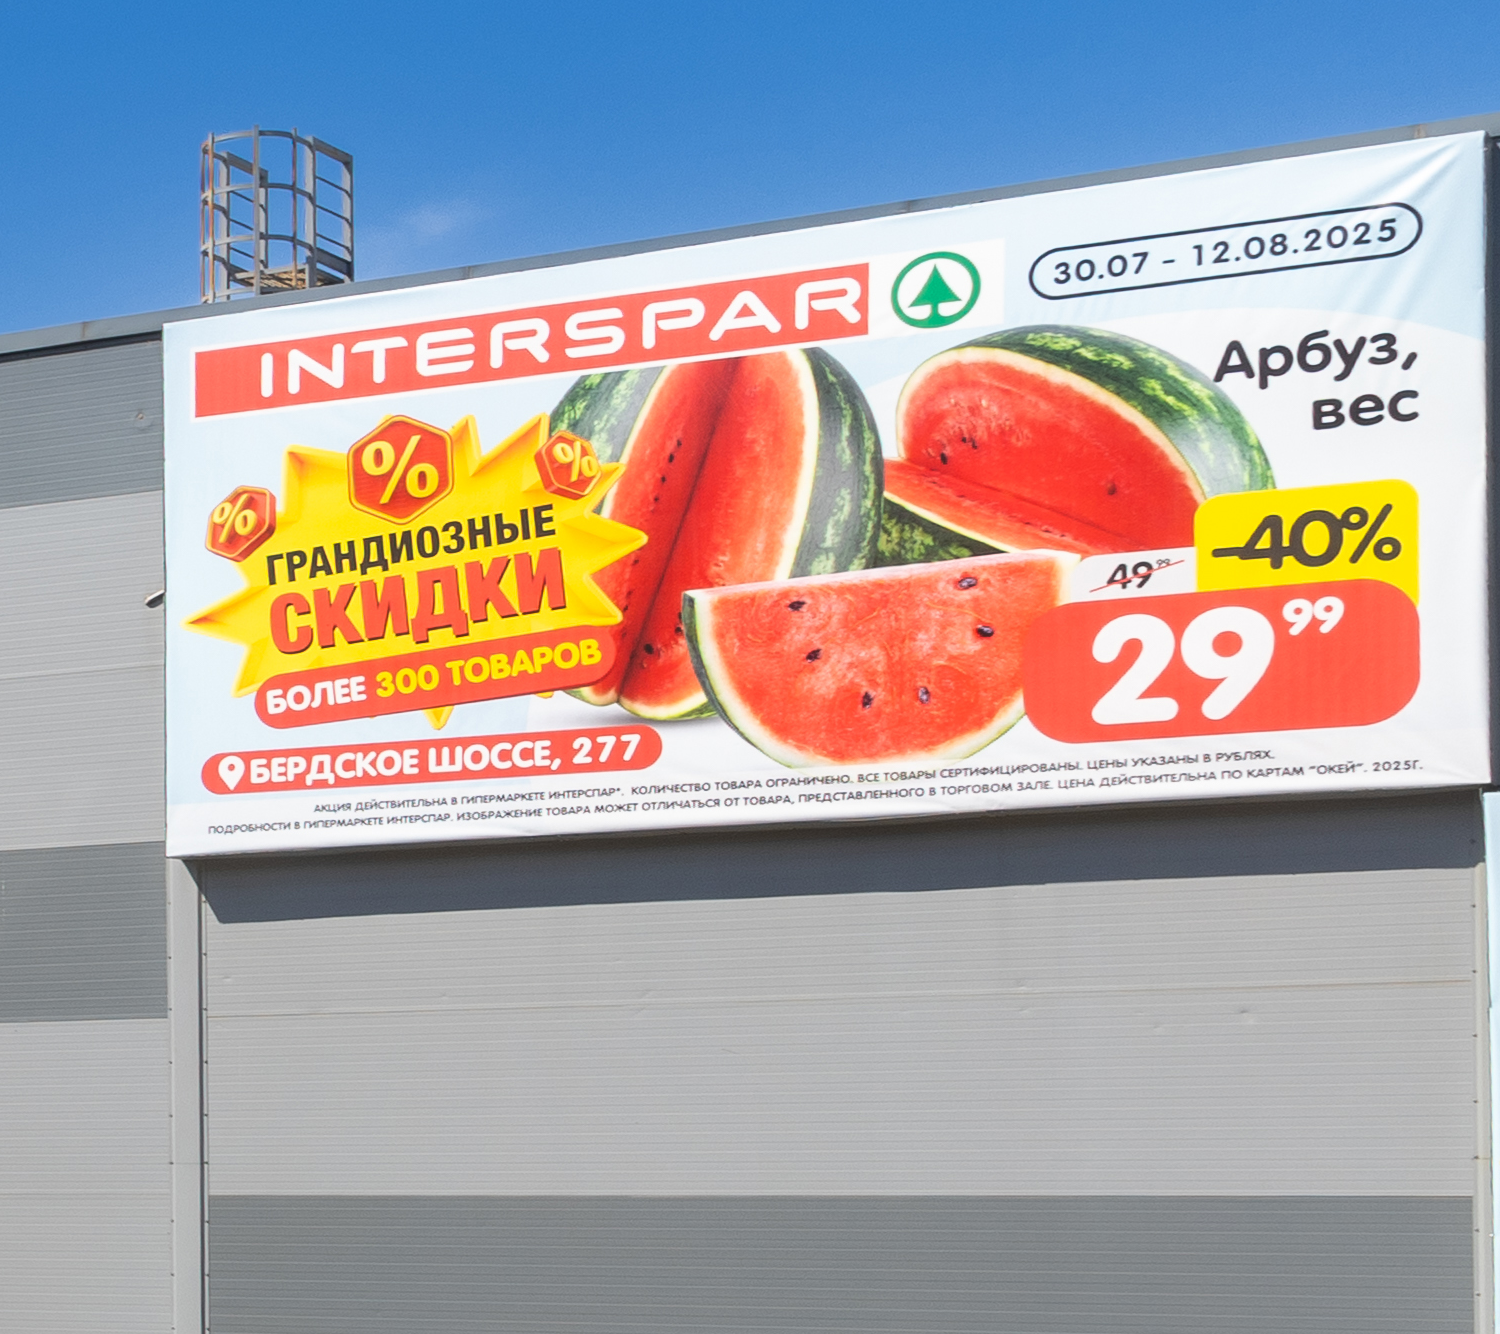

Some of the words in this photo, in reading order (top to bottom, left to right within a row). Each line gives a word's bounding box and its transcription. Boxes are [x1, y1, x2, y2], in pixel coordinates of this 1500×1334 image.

[1053, 252, 1149, 285] 30.07
[1191, 218, 1398, 267] 12.08.2025
[259, 273, 864, 400] INTERSPAR
[1213, 330, 1418, 389] Арбуз,
[1312, 389, 1419, 430] вес
[266, 503, 557, 586] ГРАНДИОЗНЫЕ
[269, 546, 567, 656] СКИДКИ
[266, 675, 367, 715] БОЛЕЕ
[376, 668, 440, 699] 300
[447, 638, 603, 686] ТОВАРОВ
[249, 747, 419, 787] БЕРДСКОЕ
[428, 739, 562, 773] ШОССЕ,
[571, 733, 643, 765] 277
[313, 801, 353, 814] АКЦИЯ
[354, 795, 449, 813] ДЕЙСТВИТЕЛЬНА
[451, 797, 459, 806] В
[460, 791, 546, 806] ГИПЕРМАРКЕТЕ
[631, 781, 711, 796] КОЛИЧЕСТВО
[714, 778, 763, 792] ТОВАРА
[857, 771, 881, 784] ВСЕ
[883, 768, 937, 782] ТОВАРЫ
[1086, 757, 1128, 772] ЦЕНЫ
[1131, 753, 1200, 769] УКАЗАНЫ
[1203, 754, 1211, 764] В
[1215, 749, 1275, 764] РУБЛЯХ.
[208, 821, 292, 836] ПОДРОБНОСТИ
[294, 820, 301, 830] В
[303, 816, 384, 830] ГИПЕРМАРКЕТЕ
[457, 806, 543, 822] ИЗОБРАЖЕНИЕ
[545, 804, 591, 817] ТОВАРА
[594, 802, 639, 815] МОЖЕТ
[641, 797, 721, 813] ОТЛИЧАТЬСЯ
[724, 796, 740, 807] ОТ
[798, 786, 925, 804] ПРЕДСТАВЛЕННОГО
[928, 786, 937, 797] В
[940, 781, 1013, 796] ТОРГОВОМ
[1057, 776, 1095, 790] ЦЕНА
[1099, 769, 1217, 788] ДЕЙСТВИТЕЛЬНА
[1220, 769, 1243, 781] ПО
[1246, 765, 1305, 779] КАРТАМ
